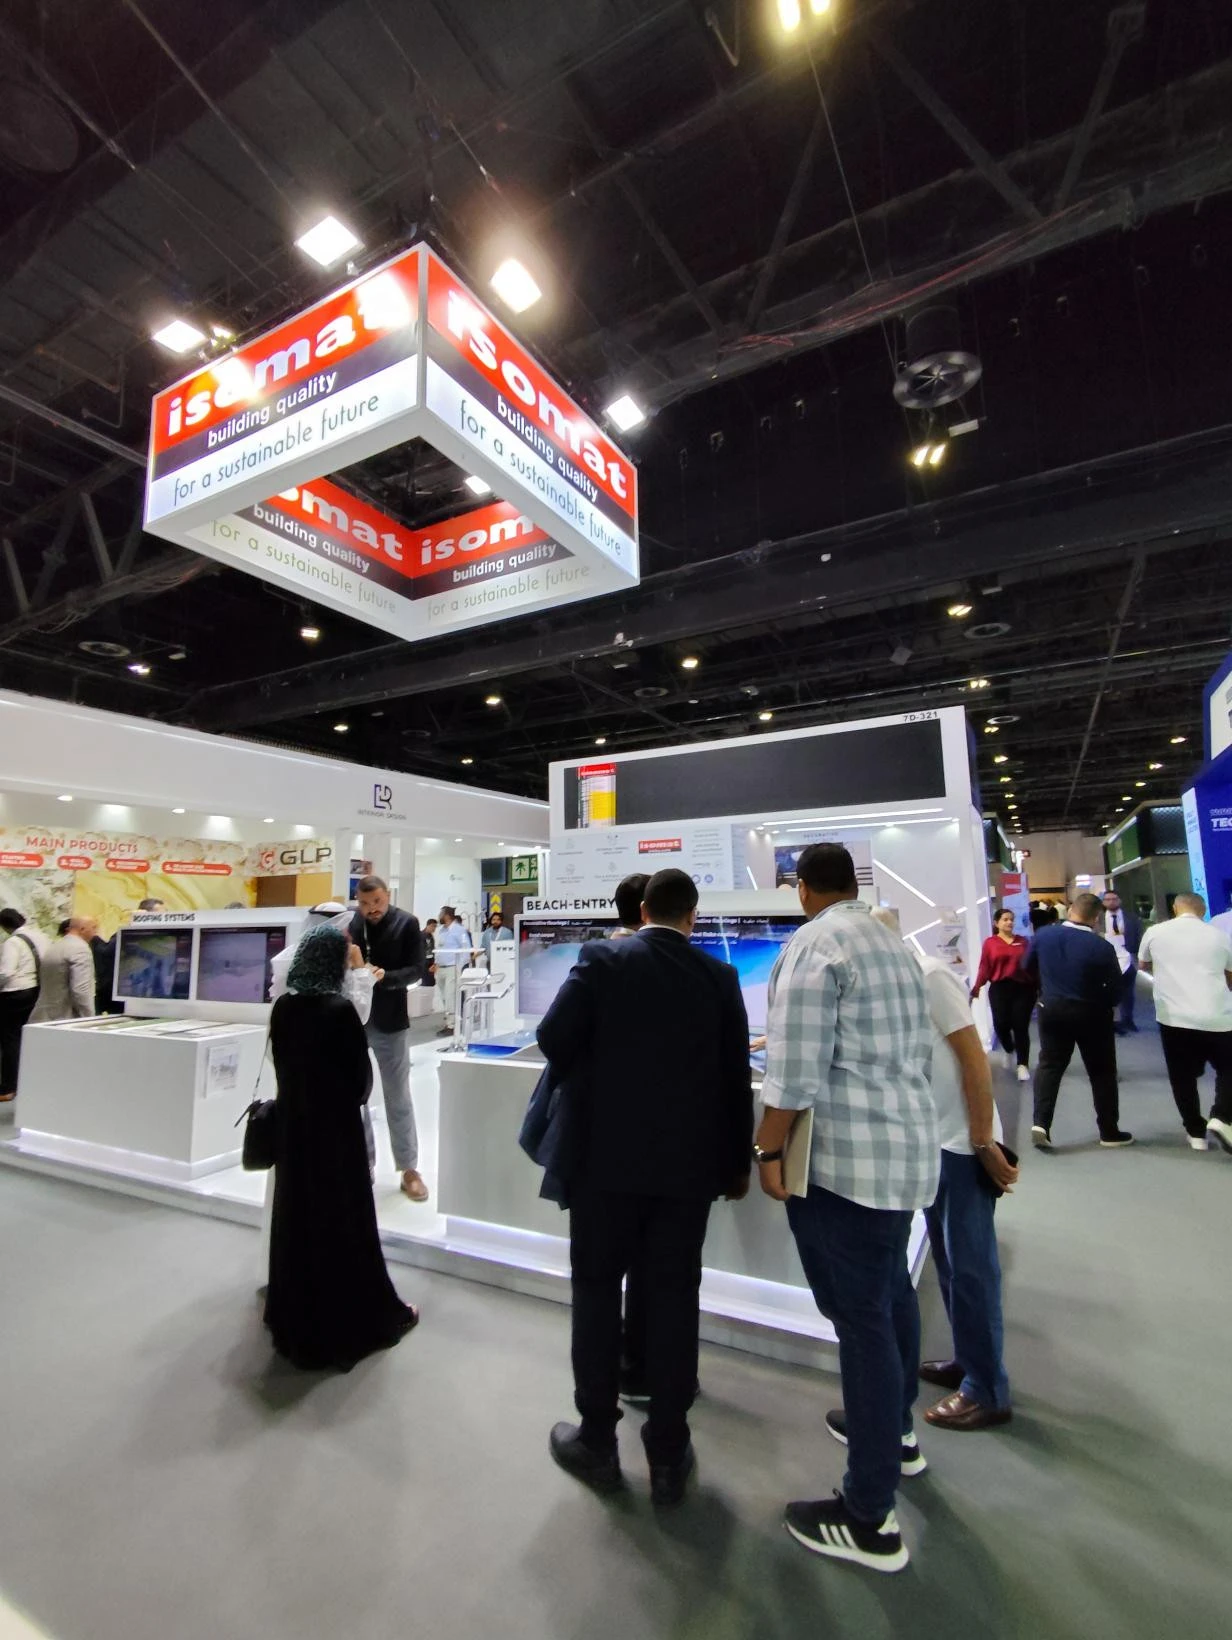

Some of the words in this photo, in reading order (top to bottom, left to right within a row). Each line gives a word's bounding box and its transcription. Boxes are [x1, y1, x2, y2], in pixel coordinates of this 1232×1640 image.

[168, 280, 393, 436] isoma
[207, 403, 270, 448] building
[276, 371, 337, 414] quality
[448, 288, 628, 499] isomat
[173, 477, 197, 506] for
[201, 473, 211, 488] a
[217, 421, 313, 482] sustainable
[321, 395, 379, 440] future
[460, 399, 487, 439] for
[494, 439, 504, 456] a
[510, 451, 586, 526] sustainable
[590, 512, 622, 556] future
[497, 395, 554, 461] building
[558, 455, 599, 503] quality
[253, 503, 317, 548] building
[322, 540, 370, 573] quality
[453, 558, 504, 583] building
[508, 544, 557, 567] quality
[248, 537, 259, 550] a
[266, 546, 353, 594] sustainable
[358, 583, 396, 614] future
[427, 601, 446, 621] for
[451, 599, 459, 611] a
[464, 578, 539, 607] sustainable
[546, 565, 590, 590] future
[903, 711, 938, 723] 7D-321
[26, 836, 65, 849] MAIN
[70, 840, 138, 854] PRODUCTS
[280, 847, 332, 866] GLP
[639, 840, 680, 850] isomat
[133, 914, 163, 923] ROOFING
[165, 913, 195, 922] SYSTEMS
[527, 899, 615, 911] BEACH-ENTRY
